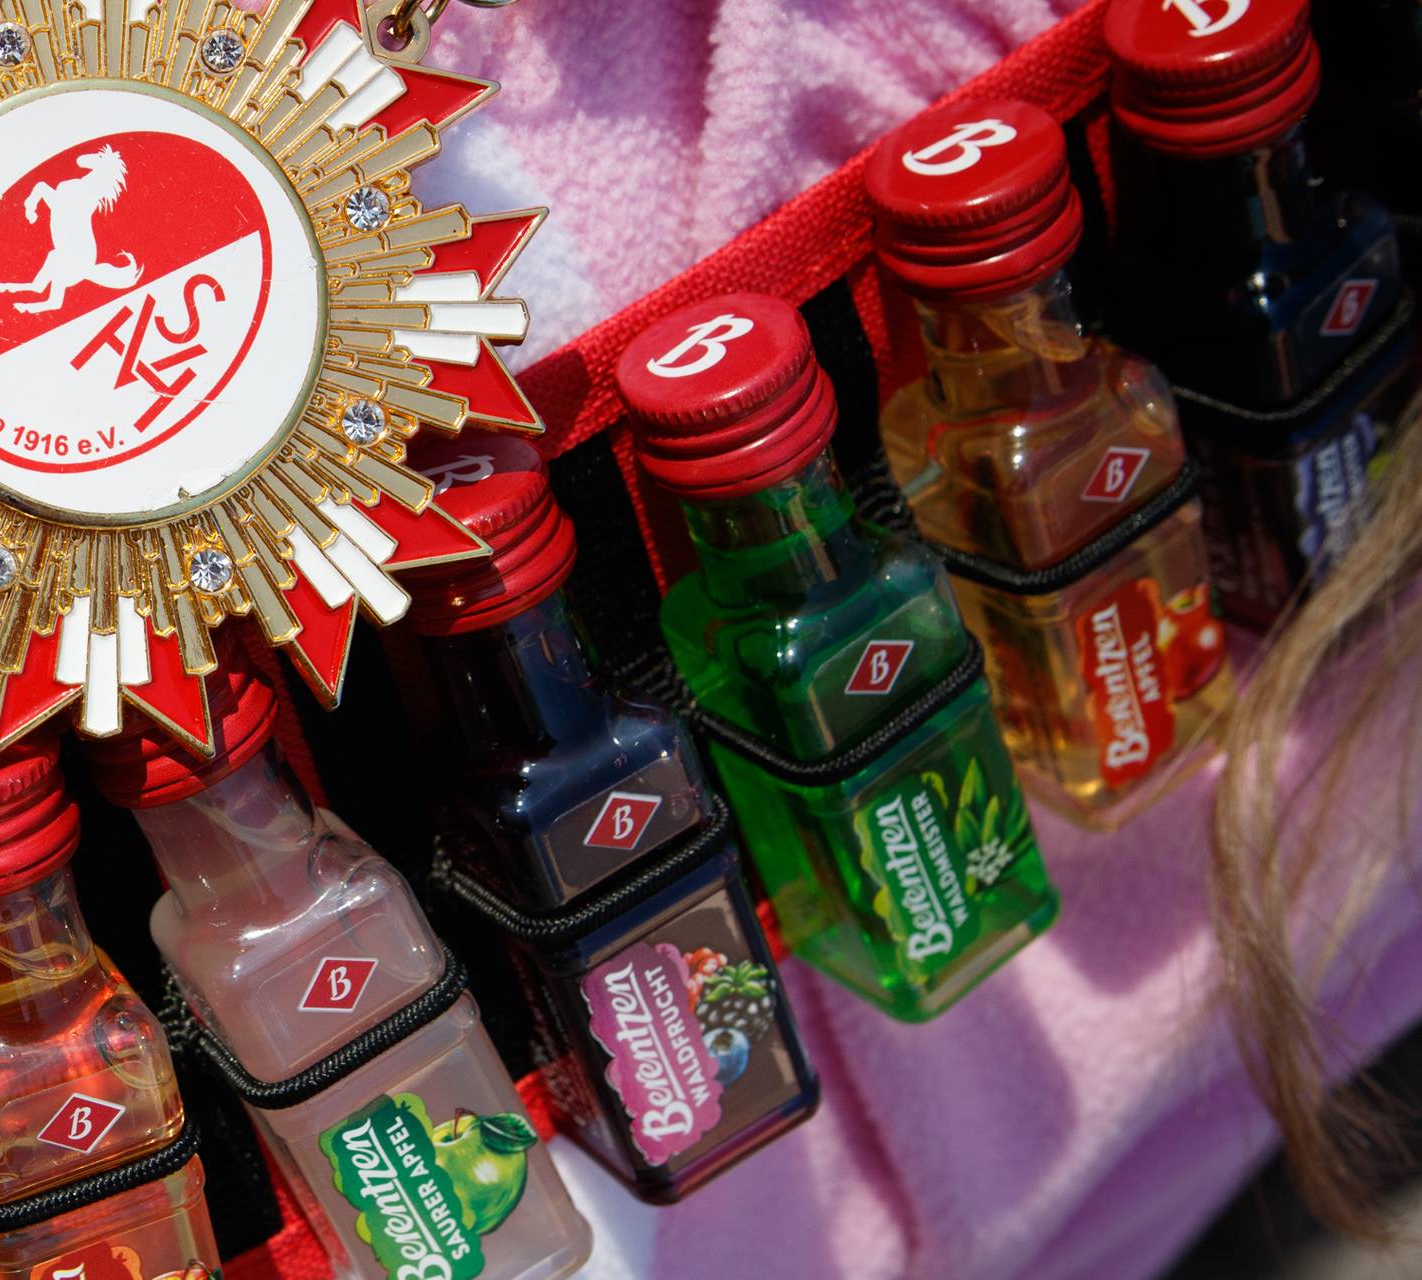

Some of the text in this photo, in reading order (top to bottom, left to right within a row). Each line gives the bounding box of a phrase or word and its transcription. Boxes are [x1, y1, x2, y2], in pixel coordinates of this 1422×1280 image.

[902, 119, 1017, 176] B
[647, 313, 753, 377] B
[13, 425, 69, 456] 1916
[77, 426, 125, 454] e.V.
[1105, 457, 1124, 493] B
[869, 650, 890, 684] B
[1092, 603, 1149, 771] Berentzen
[612, 805, 634, 840] B
[875, 794, 953, 962] Berentzen
[911, 791, 969, 928] WALDMEISTER
[327, 966, 352, 1001] B
[604, 962, 694, 1142] Berentzen
[645, 966, 711, 1107] WALDFRUCHT
[67, 1106, 92, 1140] B
[342, 1118, 452, 1280] Berentzen
[386, 1116, 470, 1260] SAURER APFEL
